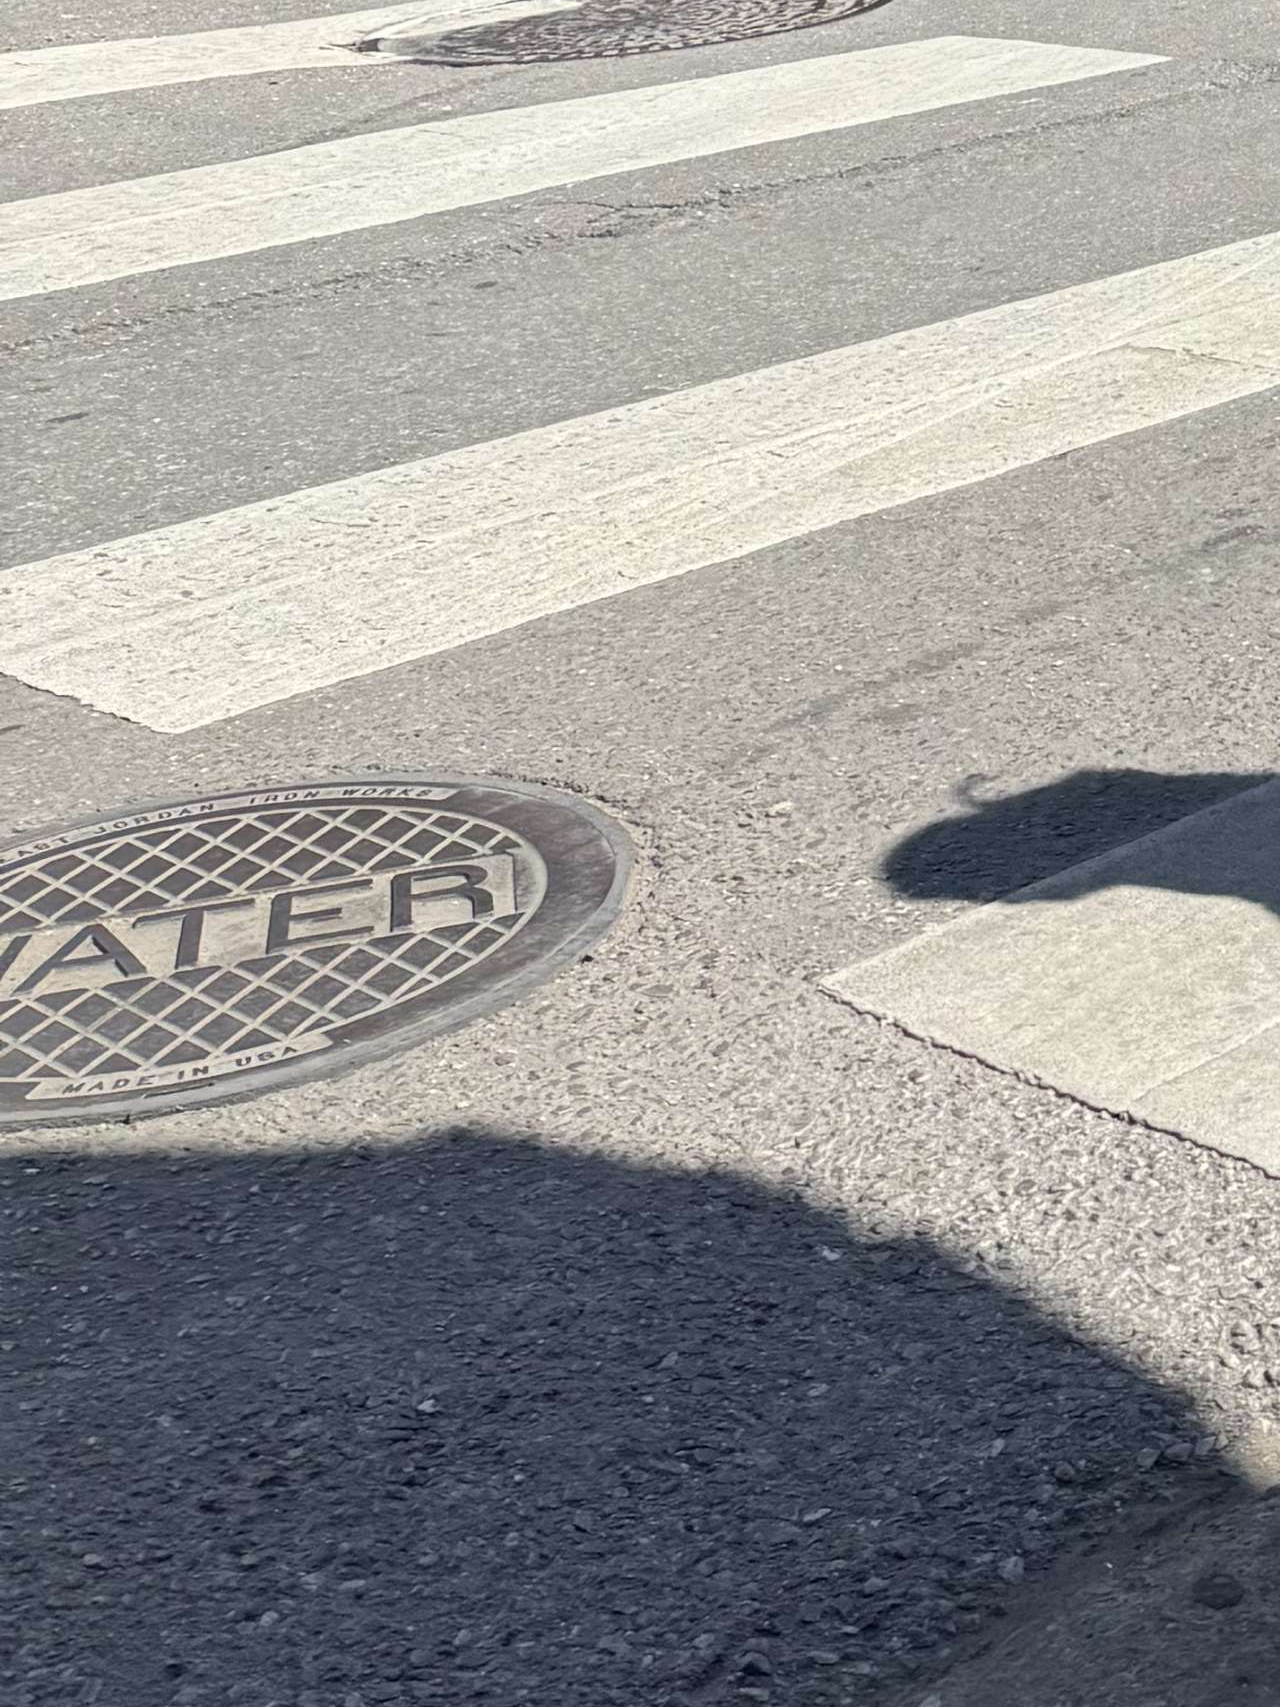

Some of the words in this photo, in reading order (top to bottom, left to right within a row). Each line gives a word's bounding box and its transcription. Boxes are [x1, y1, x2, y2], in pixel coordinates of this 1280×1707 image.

[93, 803, 214, 835] JORDAN
[342, 788, 434, 798] WORKS
[61, 1073, 157, 1094] MADE
[178, 1065, 209, 1080] IN
[236, 1046, 297, 1067] USA
